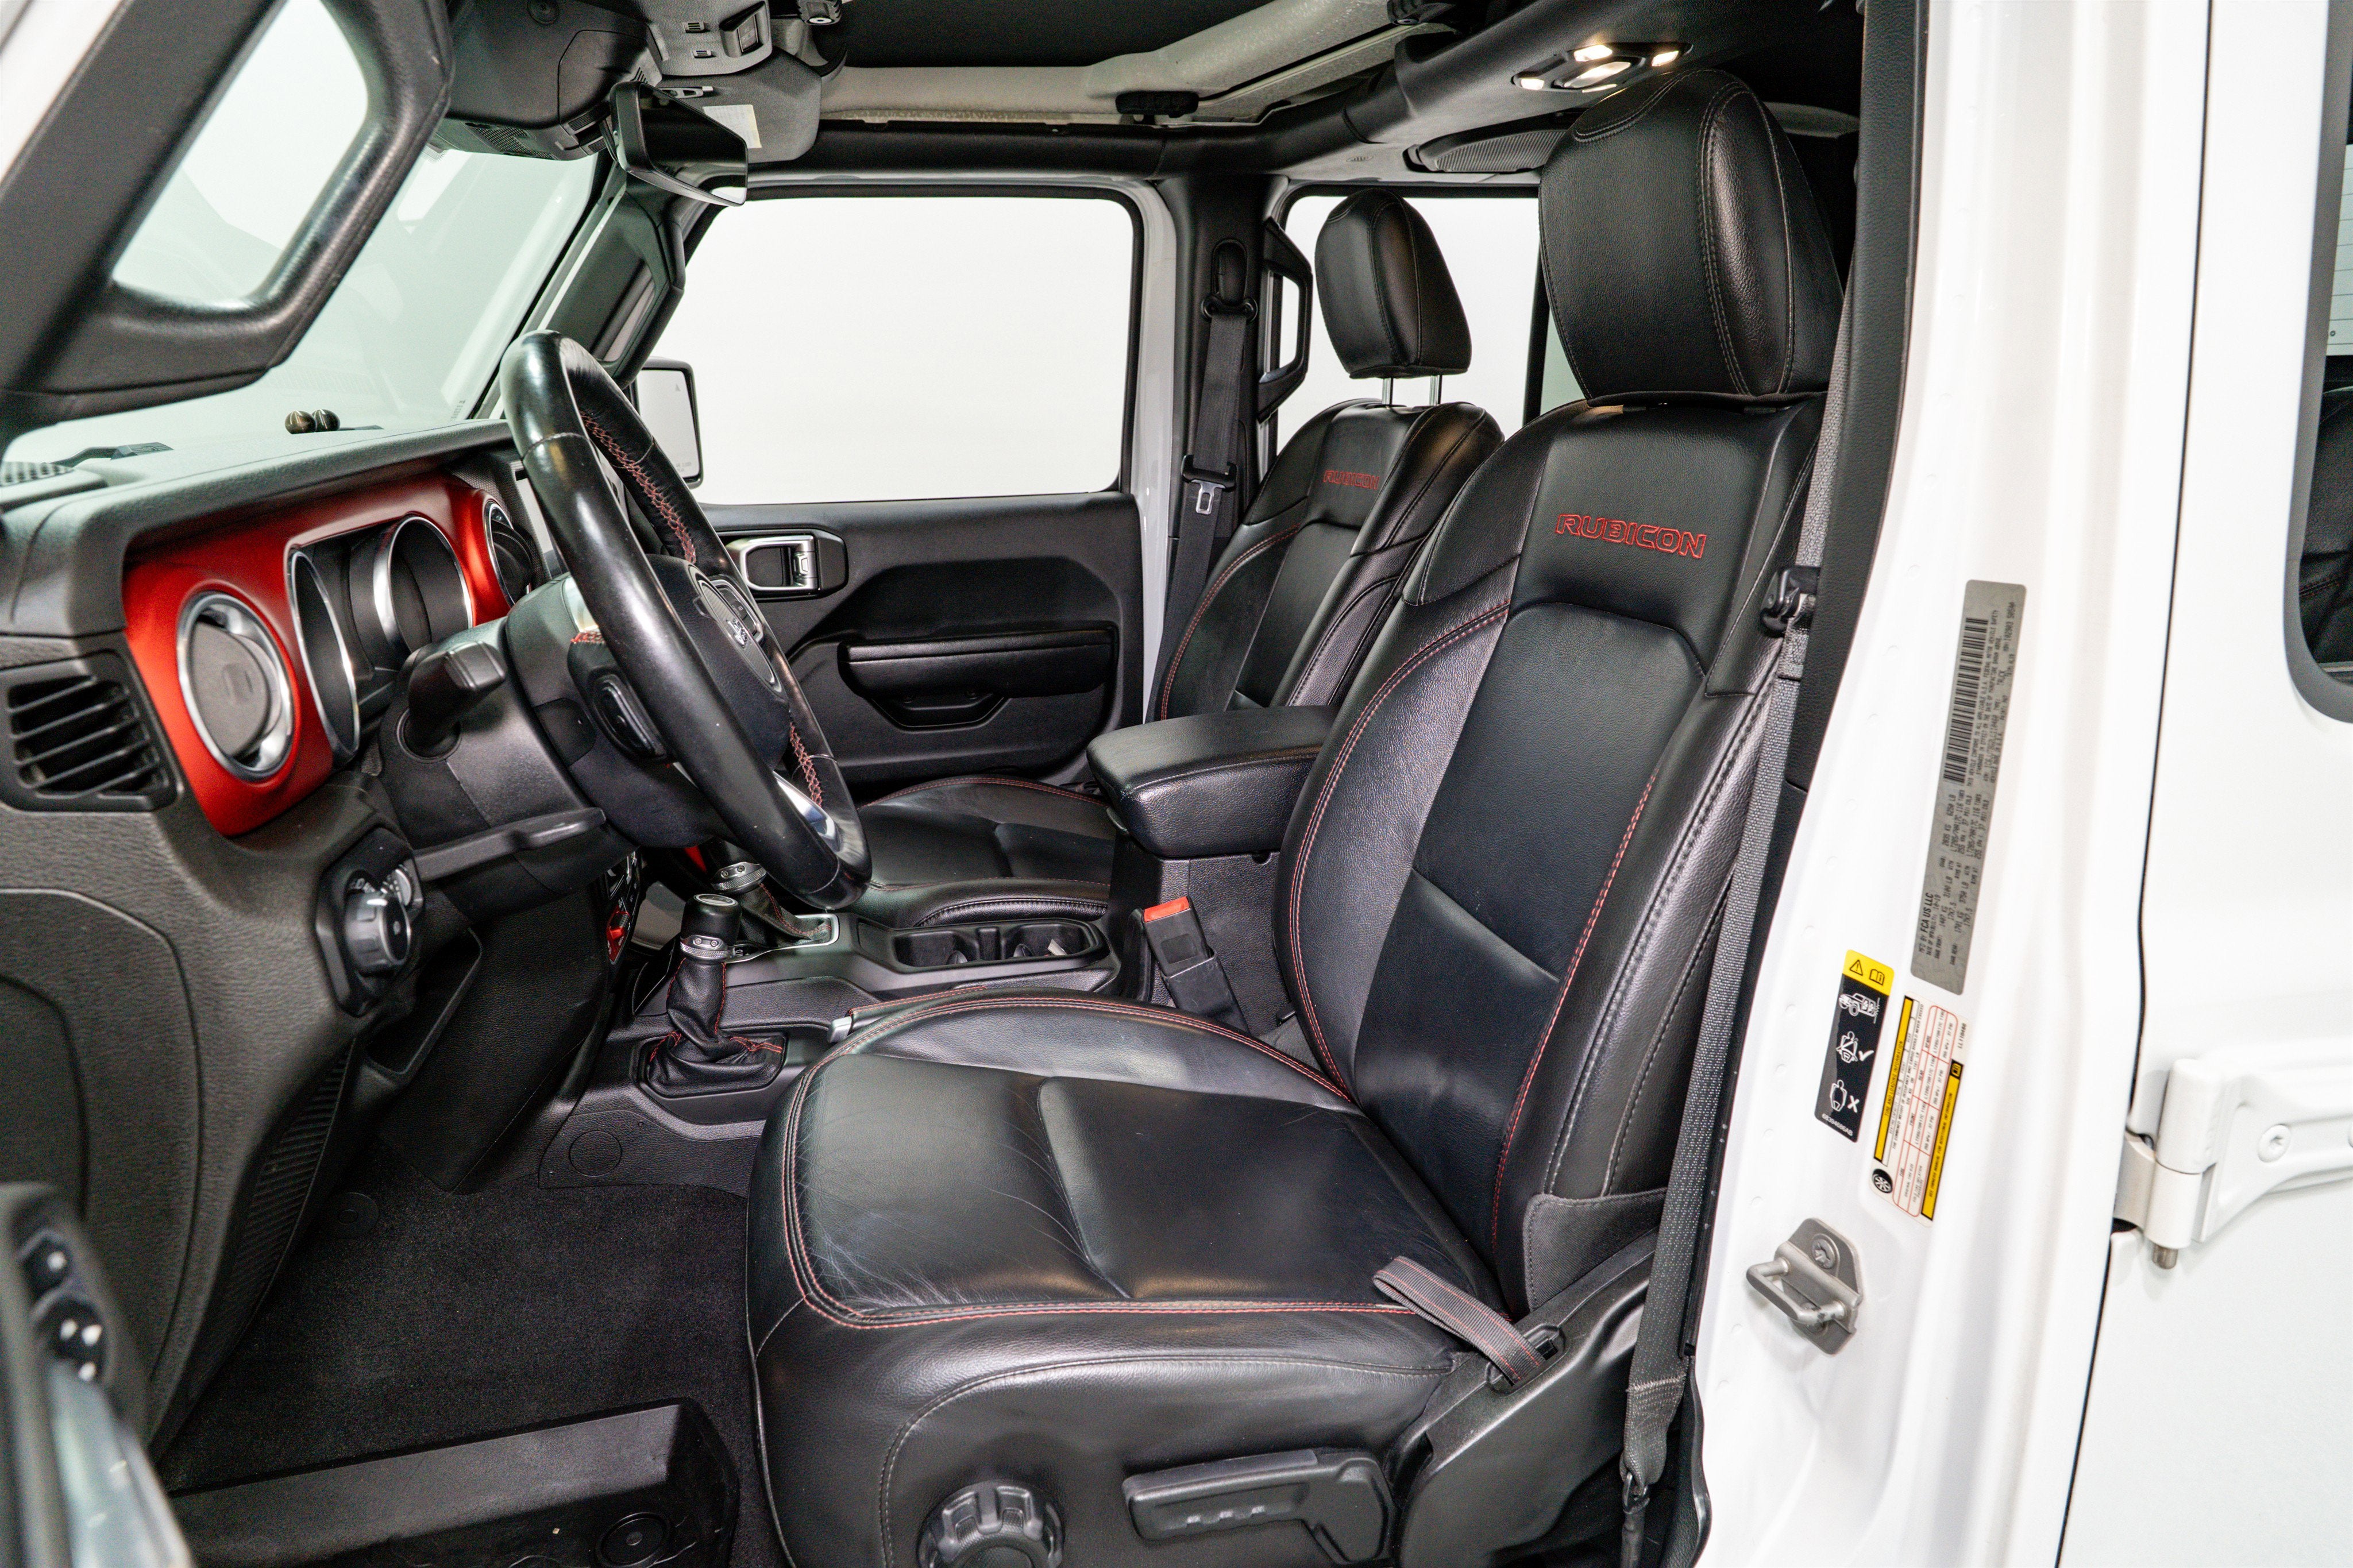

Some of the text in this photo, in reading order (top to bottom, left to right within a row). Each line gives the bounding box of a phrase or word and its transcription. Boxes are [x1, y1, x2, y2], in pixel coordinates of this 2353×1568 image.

[1323, 470, 1380, 490] RUBICON
[1554, 513, 1707, 559] RUBICON
[1924, 892, 1932, 906] LLC
[1957, 910, 1964, 918] KG
[1961, 881, 1968, 889] LB
[1922, 906, 1931, 917] US
[1920, 918, 1929, 933] FCA
[1893, 1040, 1902, 1073] INFORMATION
